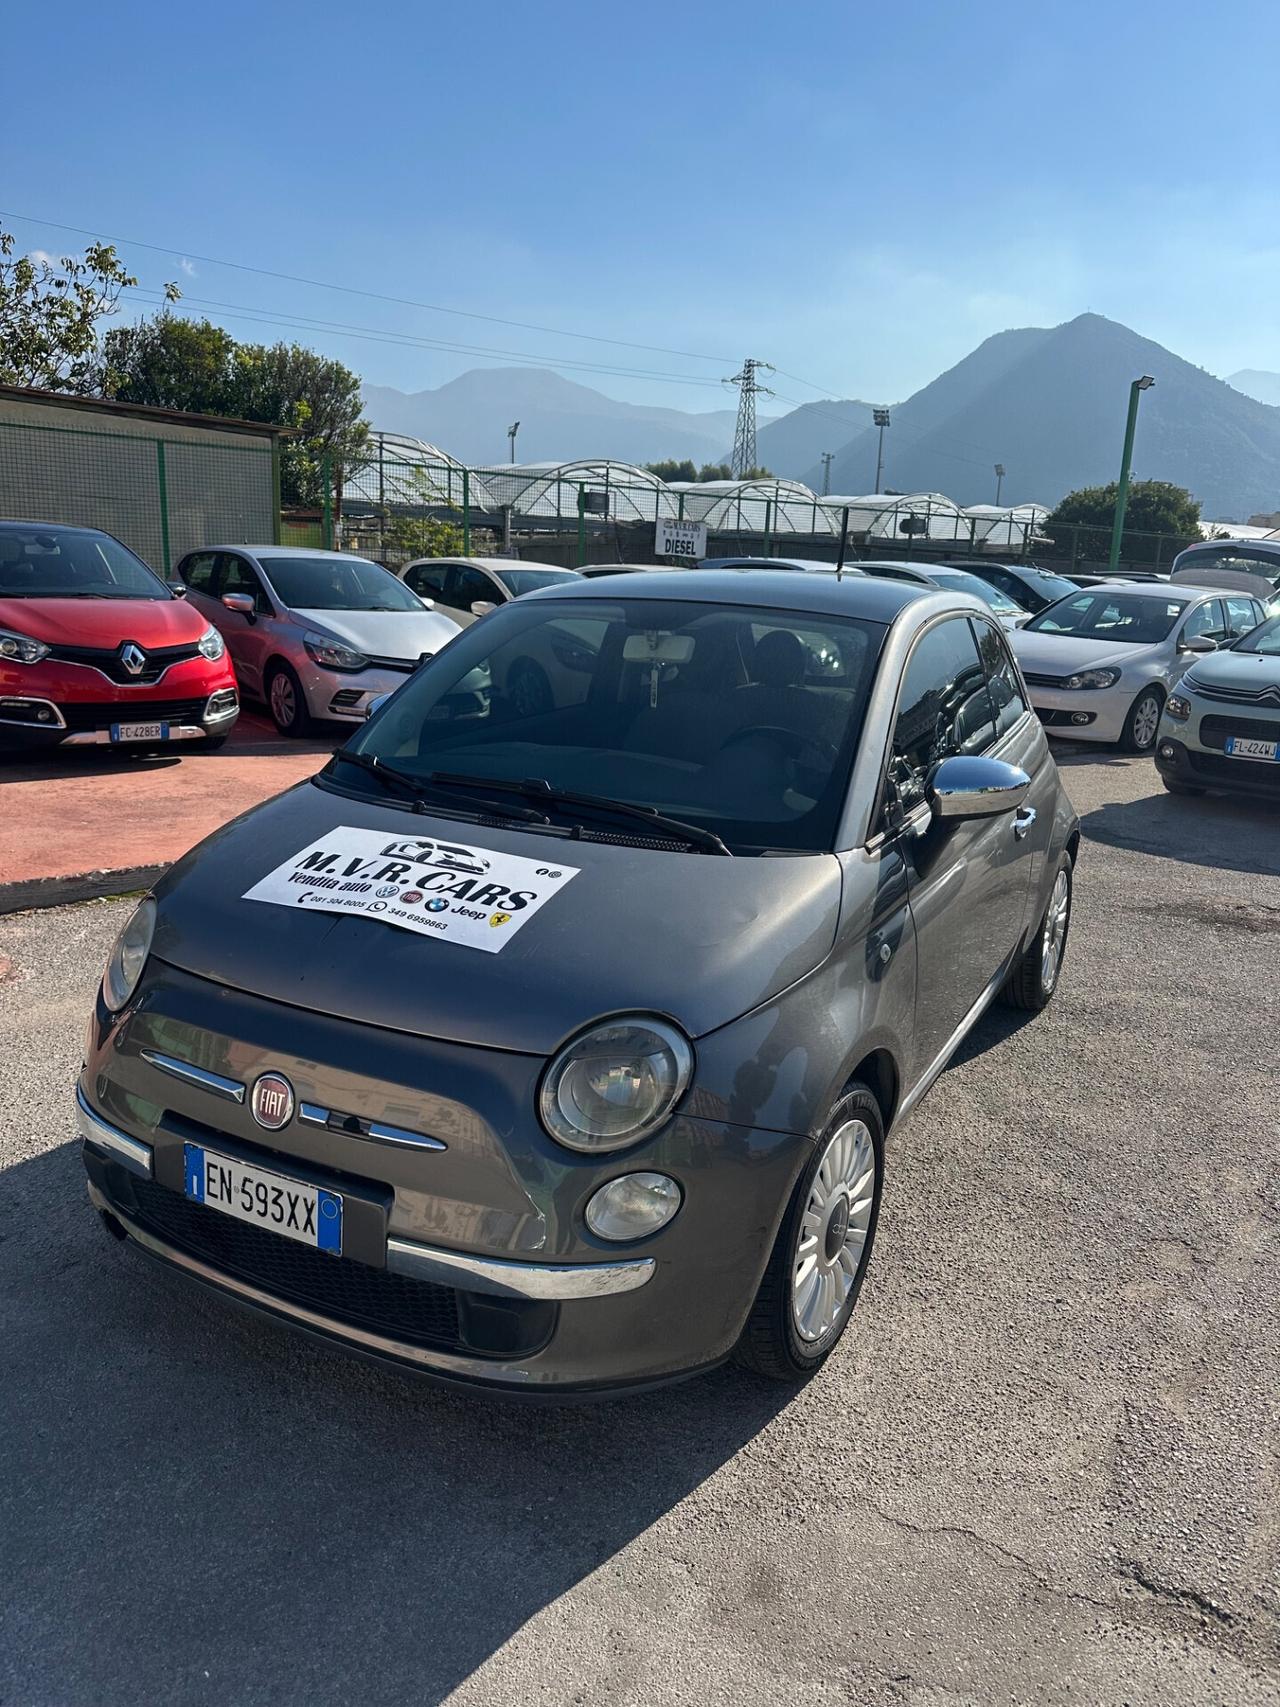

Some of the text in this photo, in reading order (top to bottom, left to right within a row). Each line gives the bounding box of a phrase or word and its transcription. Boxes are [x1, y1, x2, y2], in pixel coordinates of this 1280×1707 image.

[665, 539, 696, 555] DIESEL
[288, 872, 373, 892] Vendita auto
[388, 907, 448, 931] 349 6959863
[451, 906, 487, 921] Jeep
[260, 1089, 285, 1117] FIAT
